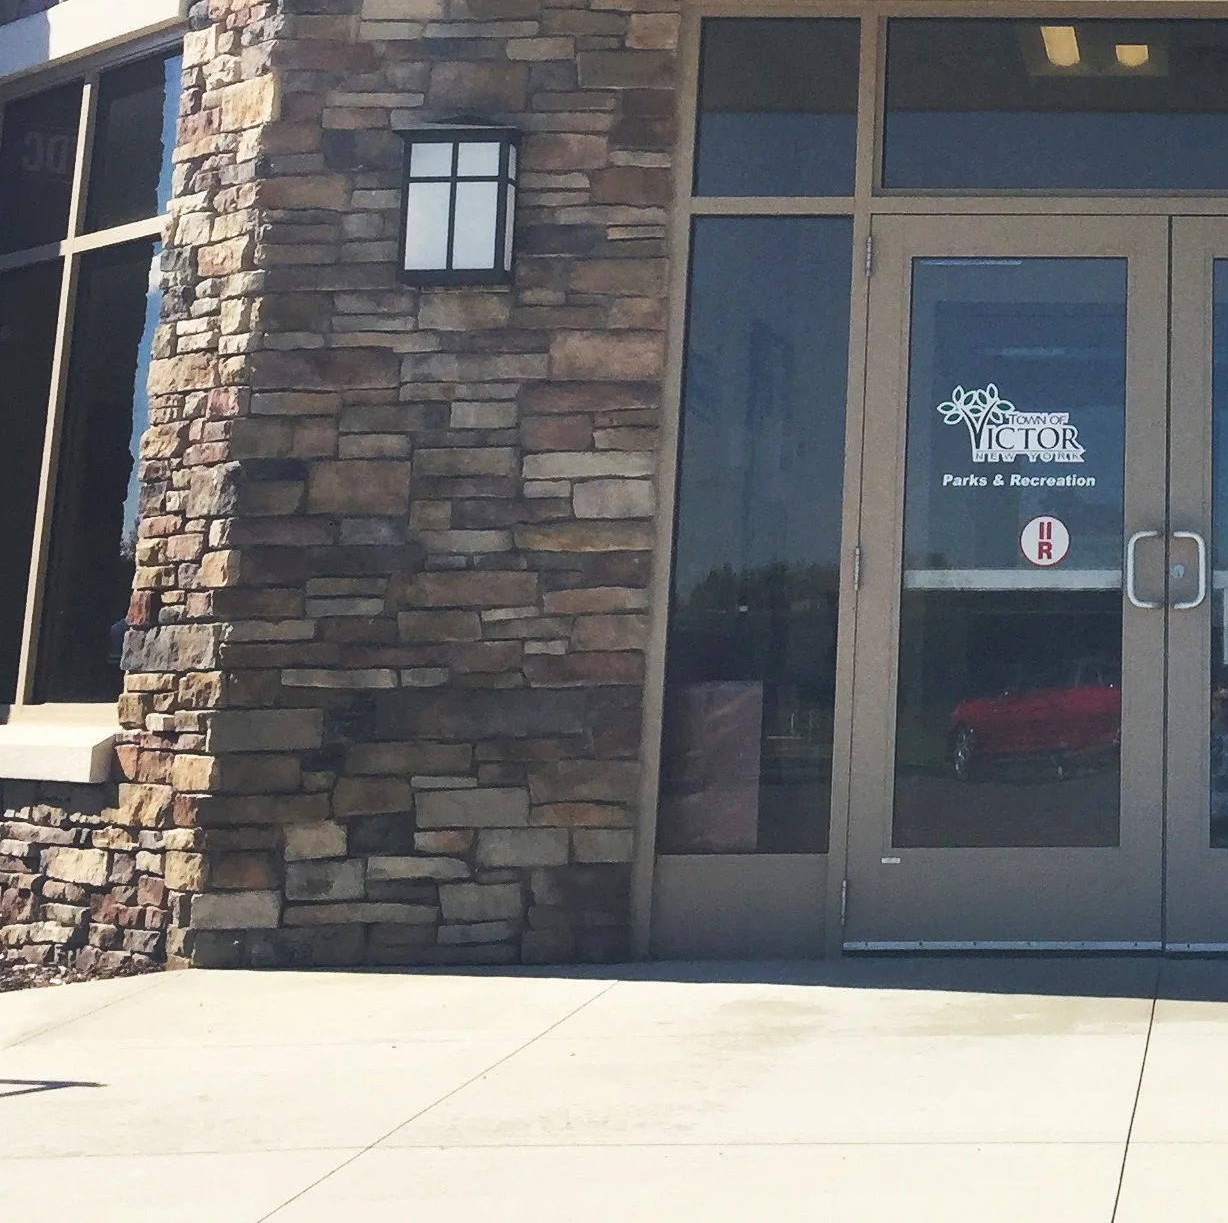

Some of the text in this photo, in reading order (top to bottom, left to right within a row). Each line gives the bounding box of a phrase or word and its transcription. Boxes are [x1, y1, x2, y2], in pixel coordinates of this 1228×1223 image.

[1009, 414, 1067, 425] TOWN OF
[975, 453, 1081, 461] NEW YORK
[942, 474, 1096, 486] Parks & Recreation
[1037, 541, 1052, 560] R
